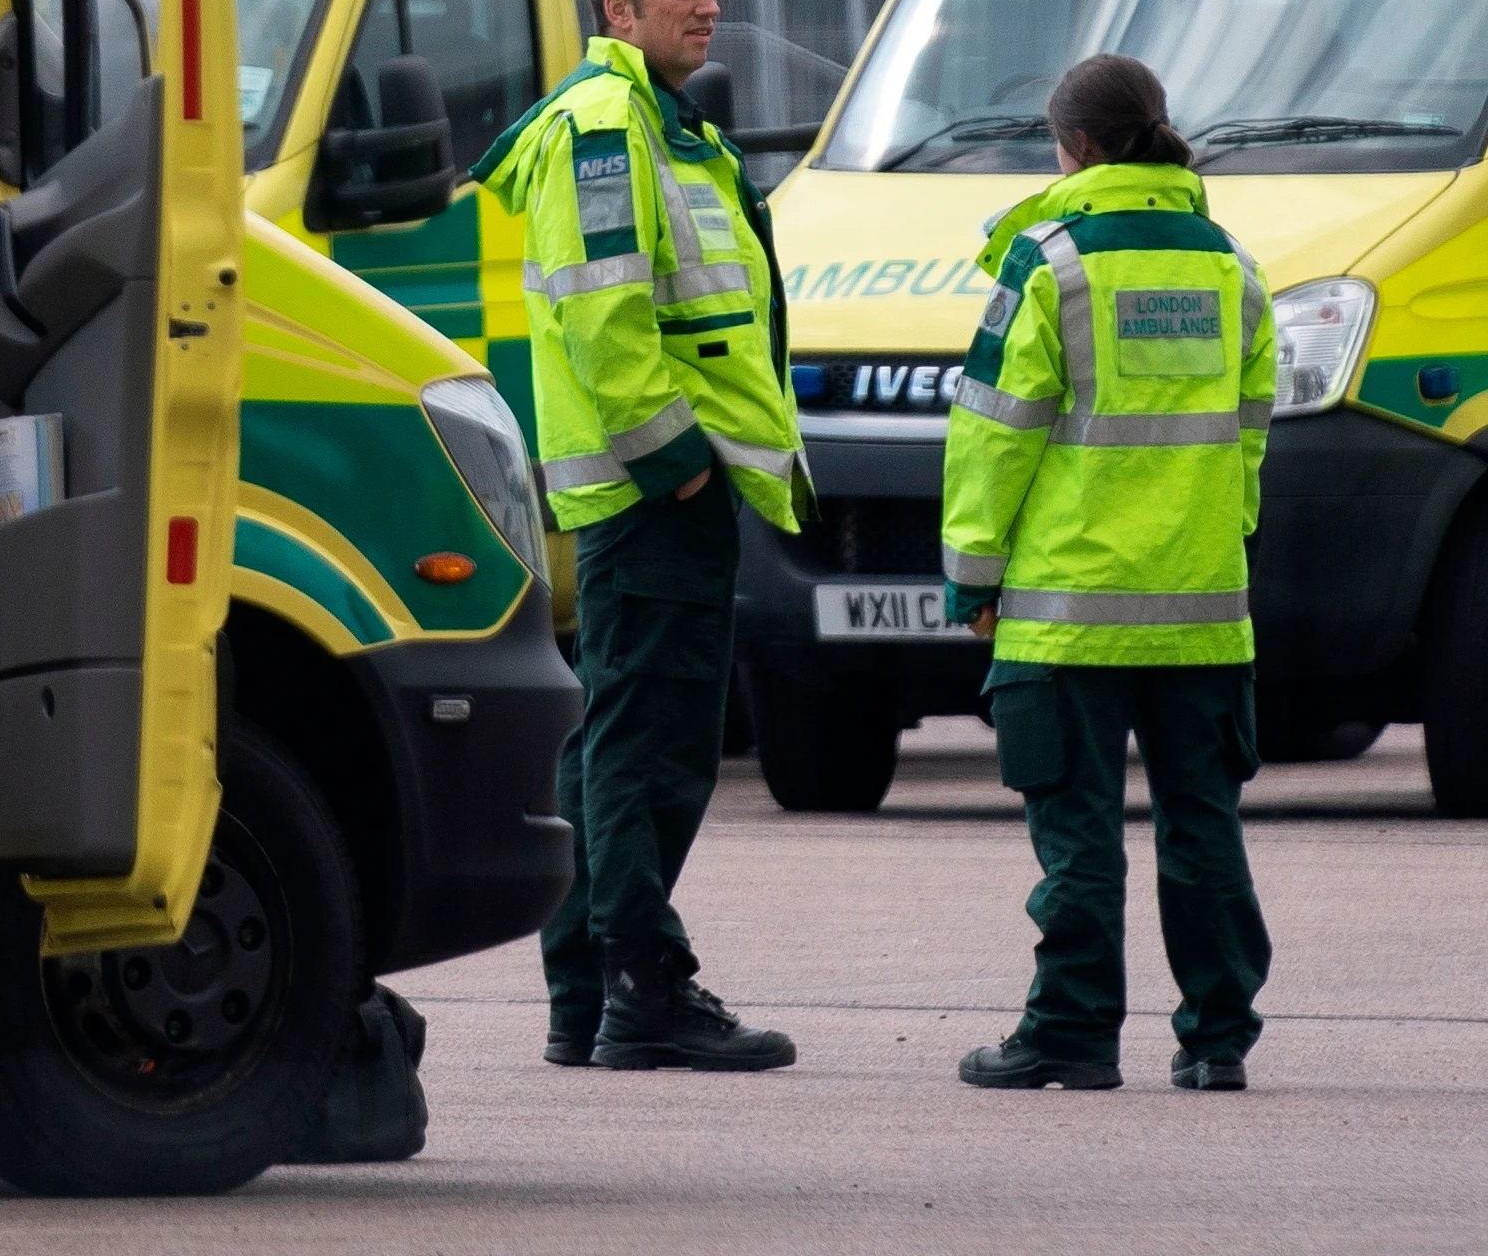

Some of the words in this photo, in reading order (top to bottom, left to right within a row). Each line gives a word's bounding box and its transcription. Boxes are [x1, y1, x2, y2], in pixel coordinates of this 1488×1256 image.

[578, 154, 627, 180] NHS
[1134, 295, 1203, 314] LONDON
[1122, 317, 1219, 335] AMBULANCE
[845, 591, 910, 628] WX11
